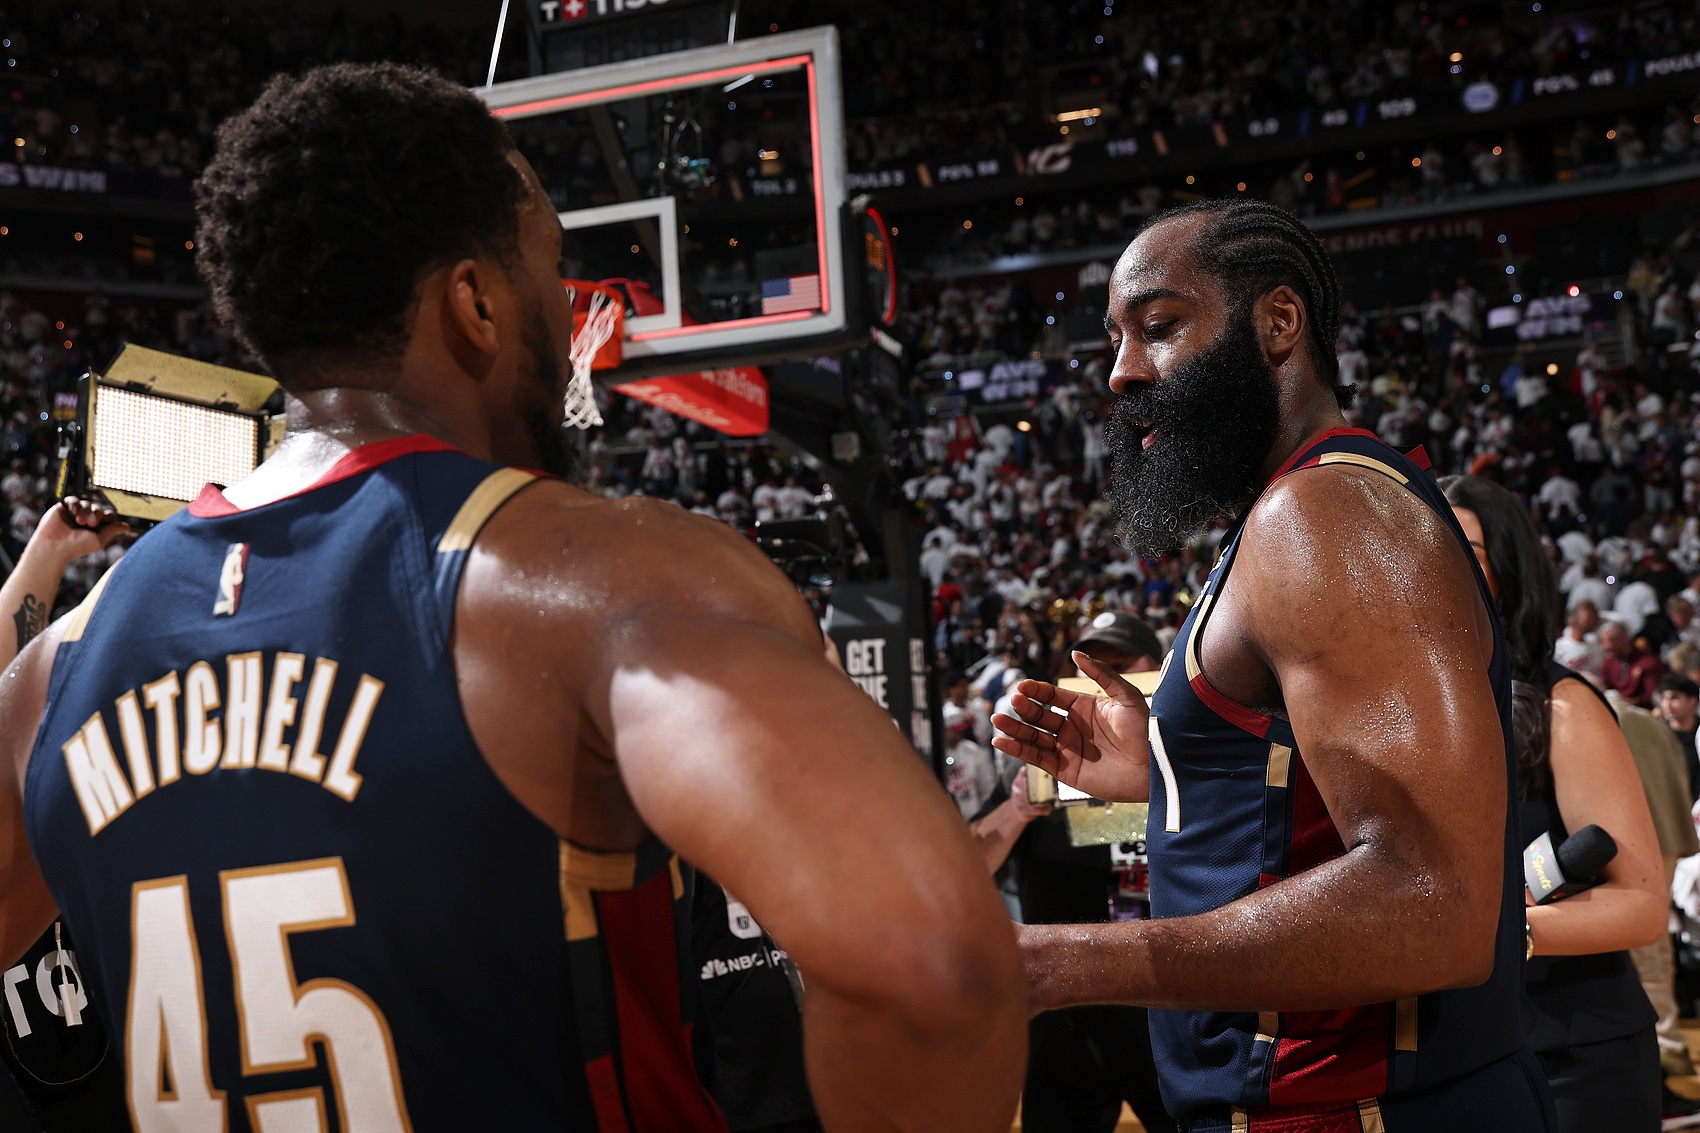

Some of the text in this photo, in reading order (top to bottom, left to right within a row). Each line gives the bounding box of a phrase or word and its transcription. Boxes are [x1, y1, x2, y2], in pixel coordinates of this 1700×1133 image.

[23, 163, 107, 193] WIN
[847, 170, 889, 190] OULS
[846, 637, 886, 676] GET
[62, 651, 385, 837] MITCHELL
[727, 951, 766, 973] NBC
[125, 856, 414, 1133] 45
